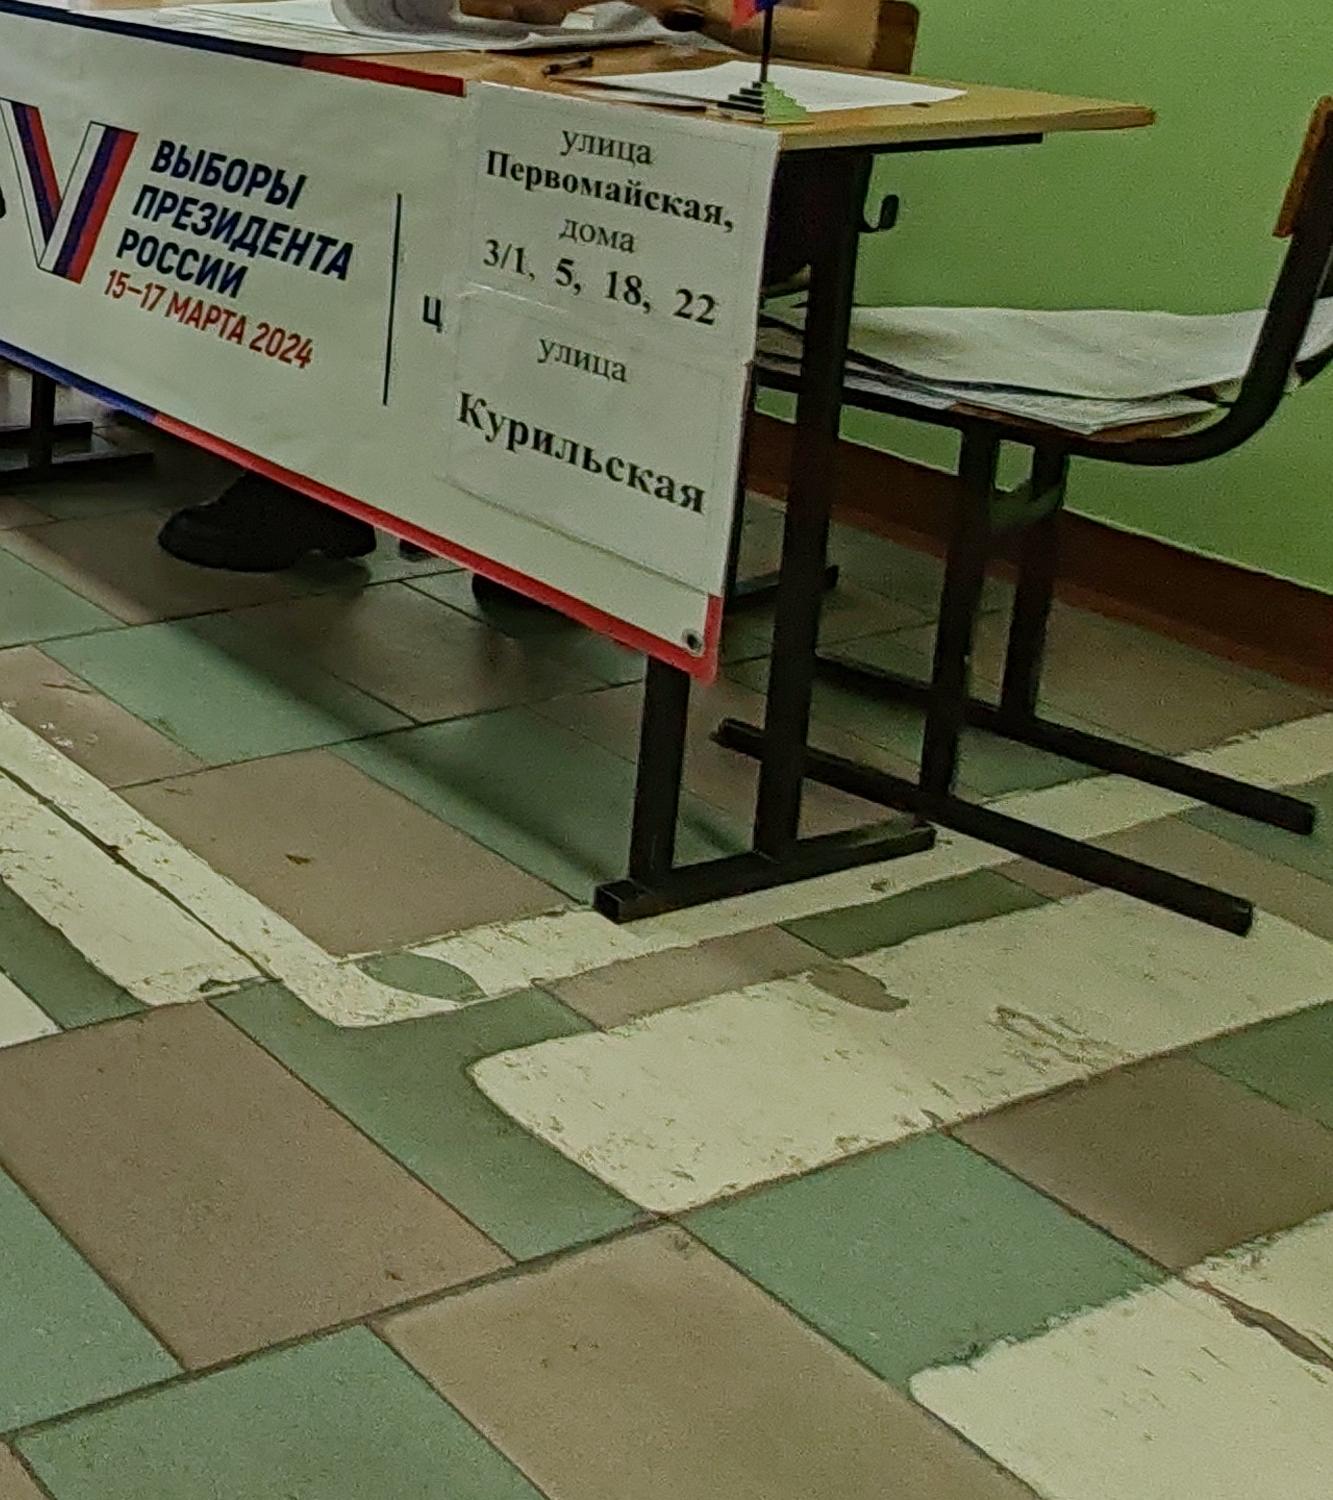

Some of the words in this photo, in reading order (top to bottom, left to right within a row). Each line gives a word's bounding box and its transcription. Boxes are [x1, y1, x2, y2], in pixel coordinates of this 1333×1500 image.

[150, 139, 308, 210] ВЫБОРЫ
[560, 129, 652, 165] улица
[486, 149, 734, 233] Первомайская,
[116, 228, 249, 299] РОССИИ
[132, 184, 354, 281] ПРЕЗИДЕНТА
[558, 218, 635, 253] дома
[483, 239, 536, 280] 3/1,
[555, 258, 582, 296] 5,
[606, 271, 651, 314] 18,
[673, 288, 717, 326] 22
[165, 291, 248, 345] МАРТА
[249, 322, 314, 369] 2024
[537, 337, 628, 383] улица
[456, 391, 706, 515] Курильская
